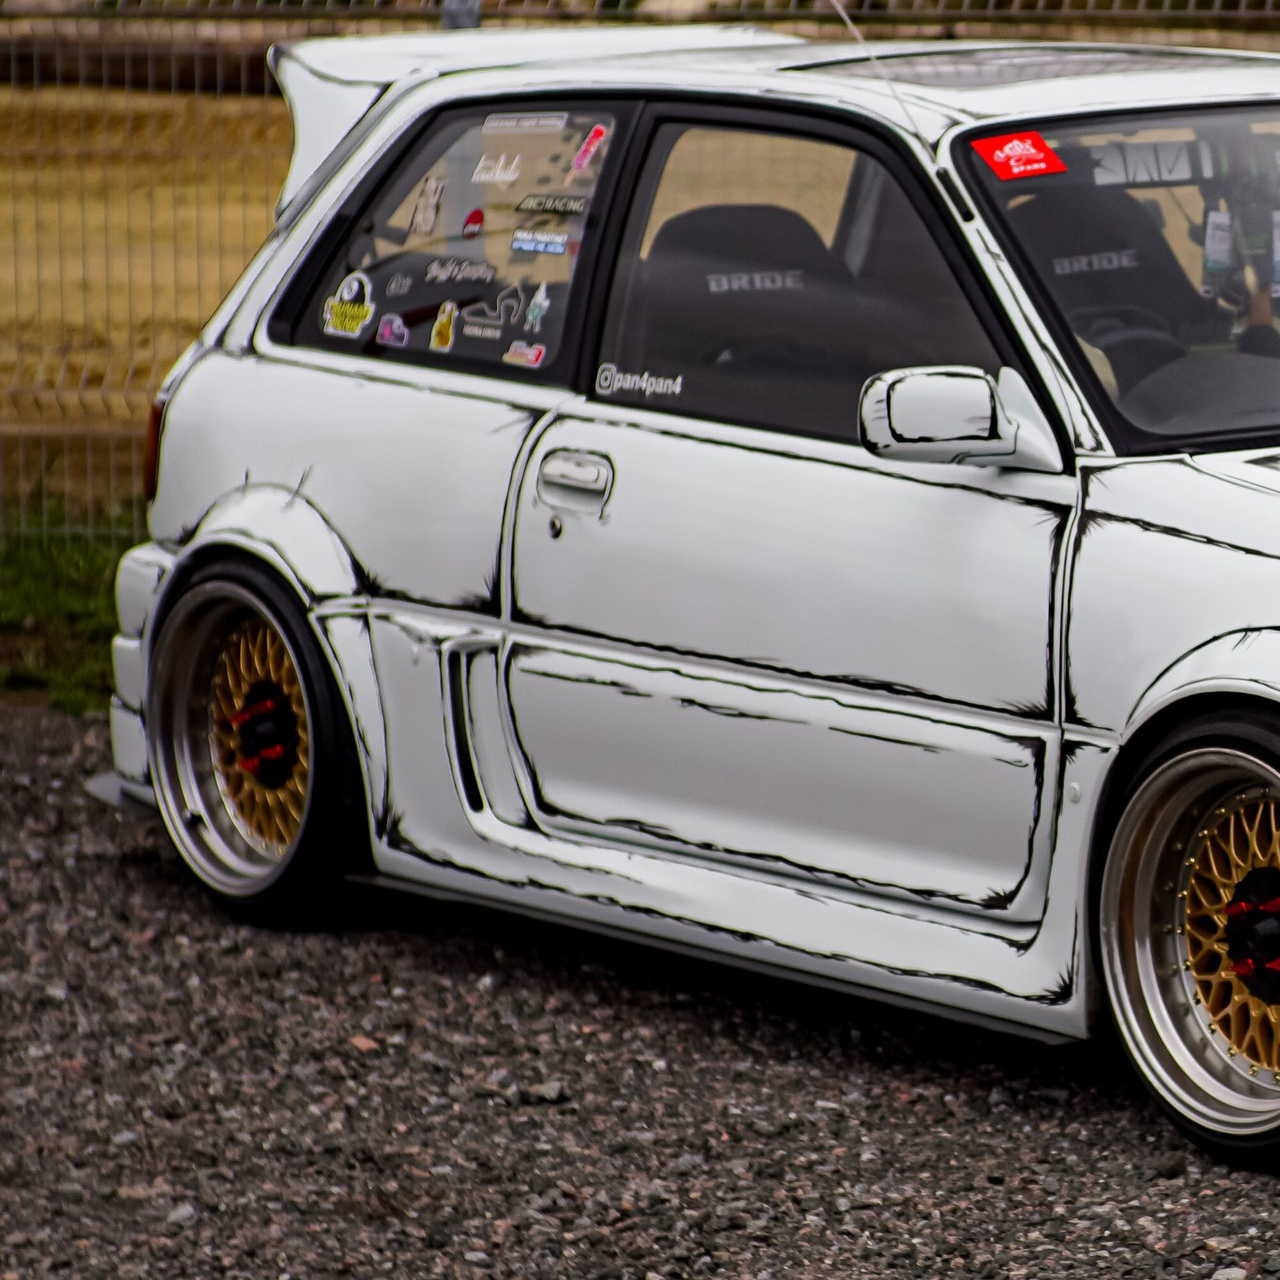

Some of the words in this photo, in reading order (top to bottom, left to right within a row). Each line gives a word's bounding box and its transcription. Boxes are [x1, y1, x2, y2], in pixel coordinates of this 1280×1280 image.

[544, 196, 586, 212] RACING
[1052, 249, 1139, 276] BRIDE
[706, 269, 804, 293] BRIDE
